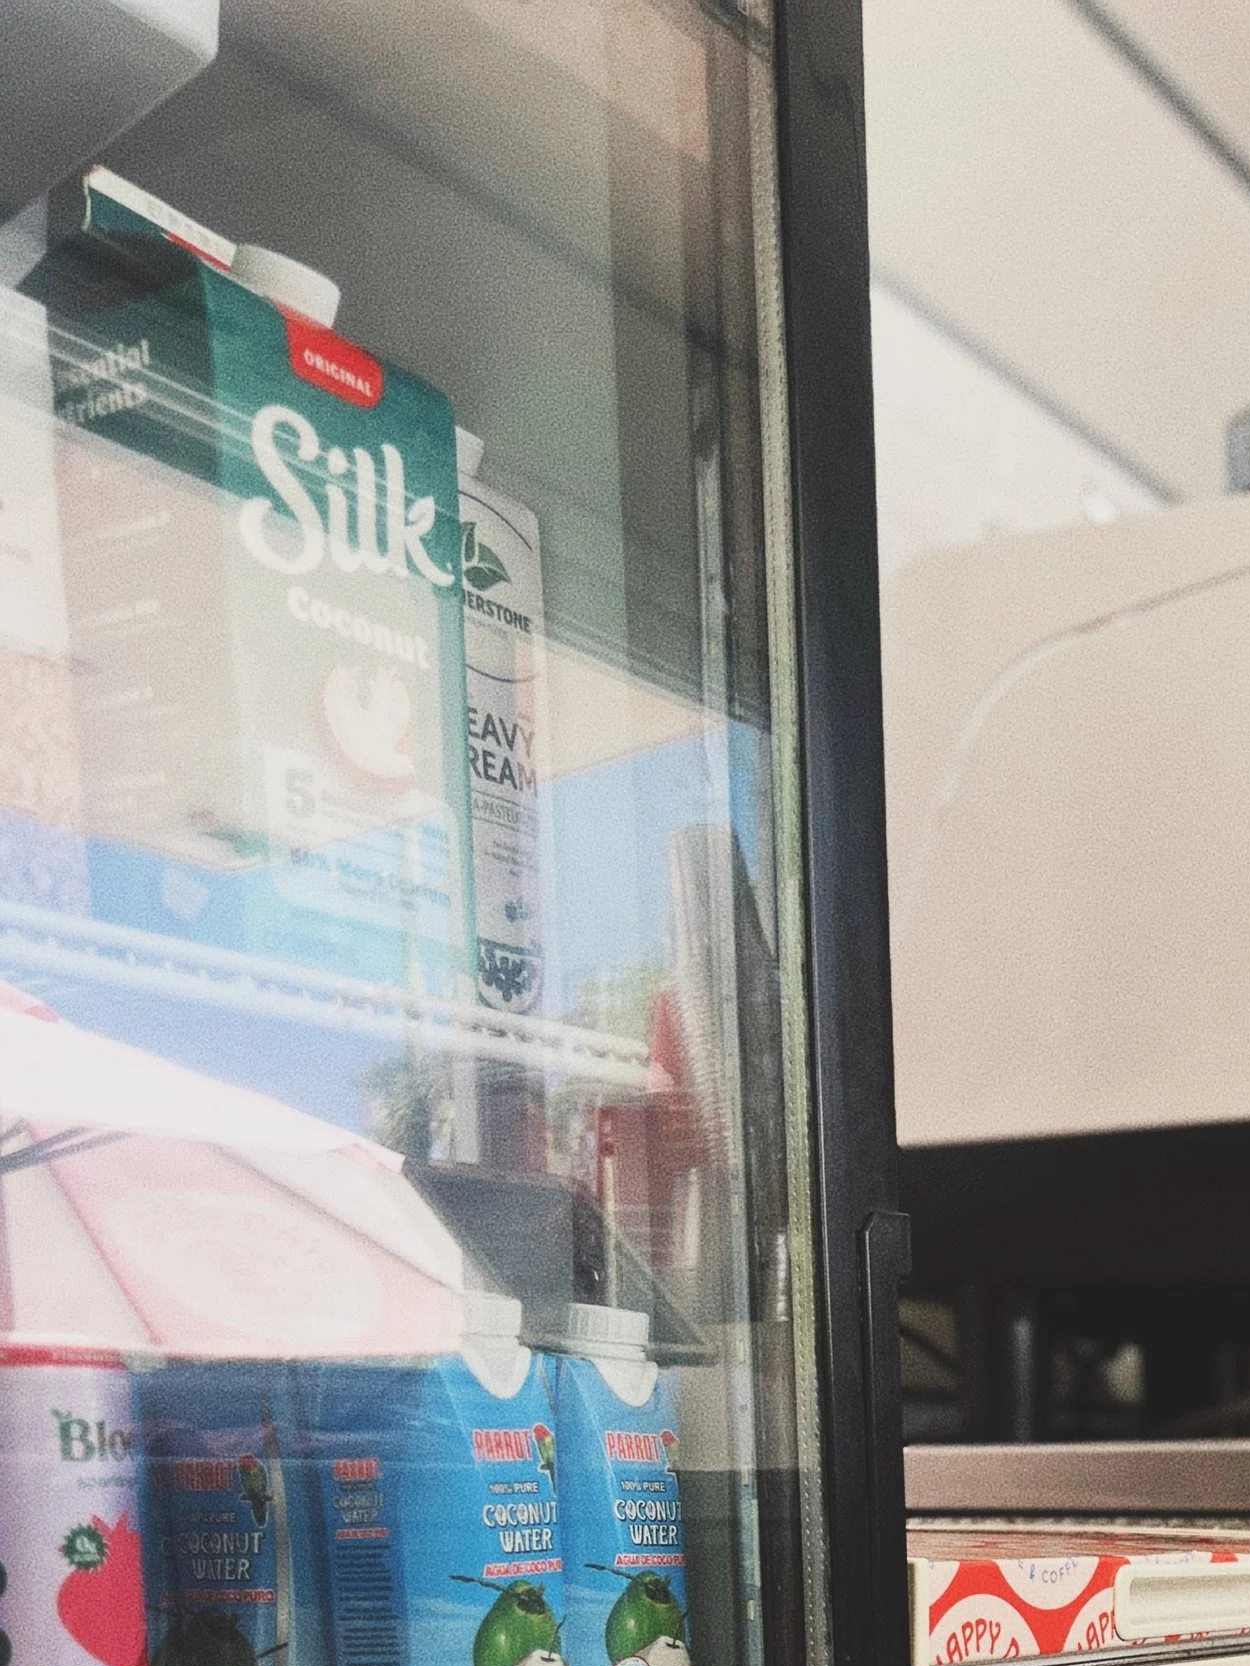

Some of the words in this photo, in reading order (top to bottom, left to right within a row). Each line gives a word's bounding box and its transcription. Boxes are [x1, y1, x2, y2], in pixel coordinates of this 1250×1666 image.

[303, 348, 374, 399] ORIGINAL
[239, 404, 455, 588] Silk
[462, 588, 534, 635] ERSTONE
[287, 586, 429, 669] Coconut
[467, 706, 535, 758] EAVY
[467, 744, 538, 798] REAM
[472, 1429, 533, 1461] PARROT
[605, 1431, 660, 1462] PARROT
[513, 1481, 539, 1494] PURE
[643, 1481, 667, 1493] PURE
[483, 1501, 558, 1528] COCONUT
[614, 1499, 682, 1521] COCONUT
[499, 1528, 553, 1554] WATER
[629, 1524, 679, 1546] WATER
